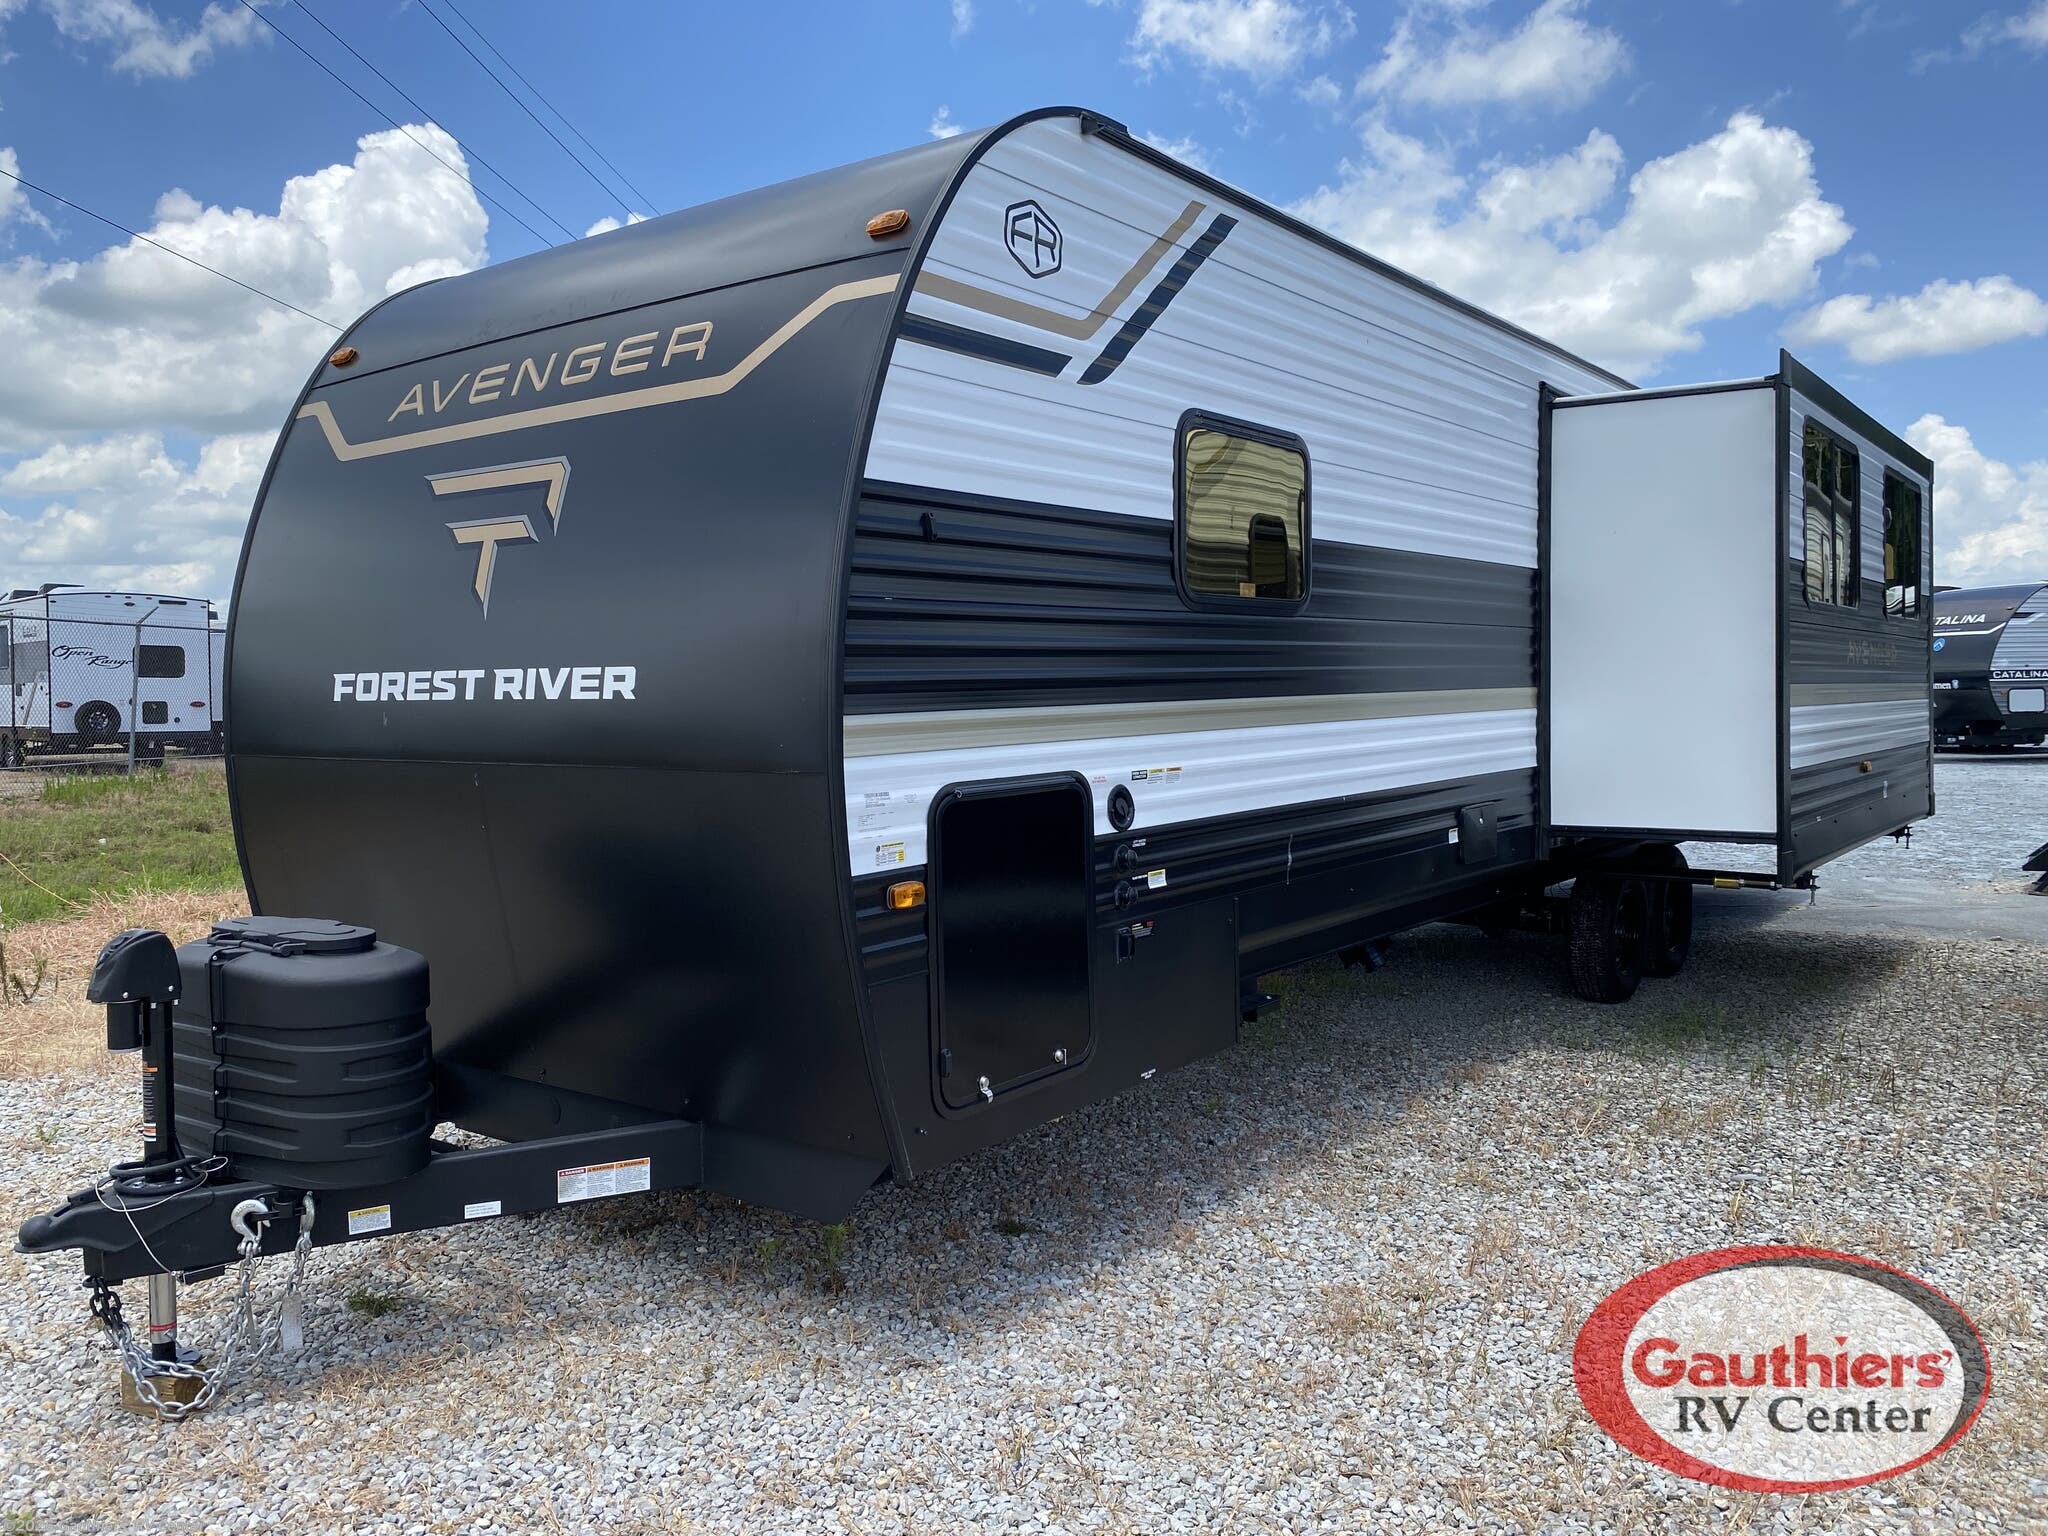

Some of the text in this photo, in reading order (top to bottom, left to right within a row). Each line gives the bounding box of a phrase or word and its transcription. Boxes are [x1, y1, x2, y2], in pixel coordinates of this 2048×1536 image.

[387, 321, 714, 422] AVENGER
[1934, 614, 1986, 625] TALINA
[52, 645, 94, 660] Open
[85, 656, 134, 669] Range
[1993, 670, 2048, 679] CATALINA
[333, 666, 637, 702] FOREST RIVER
